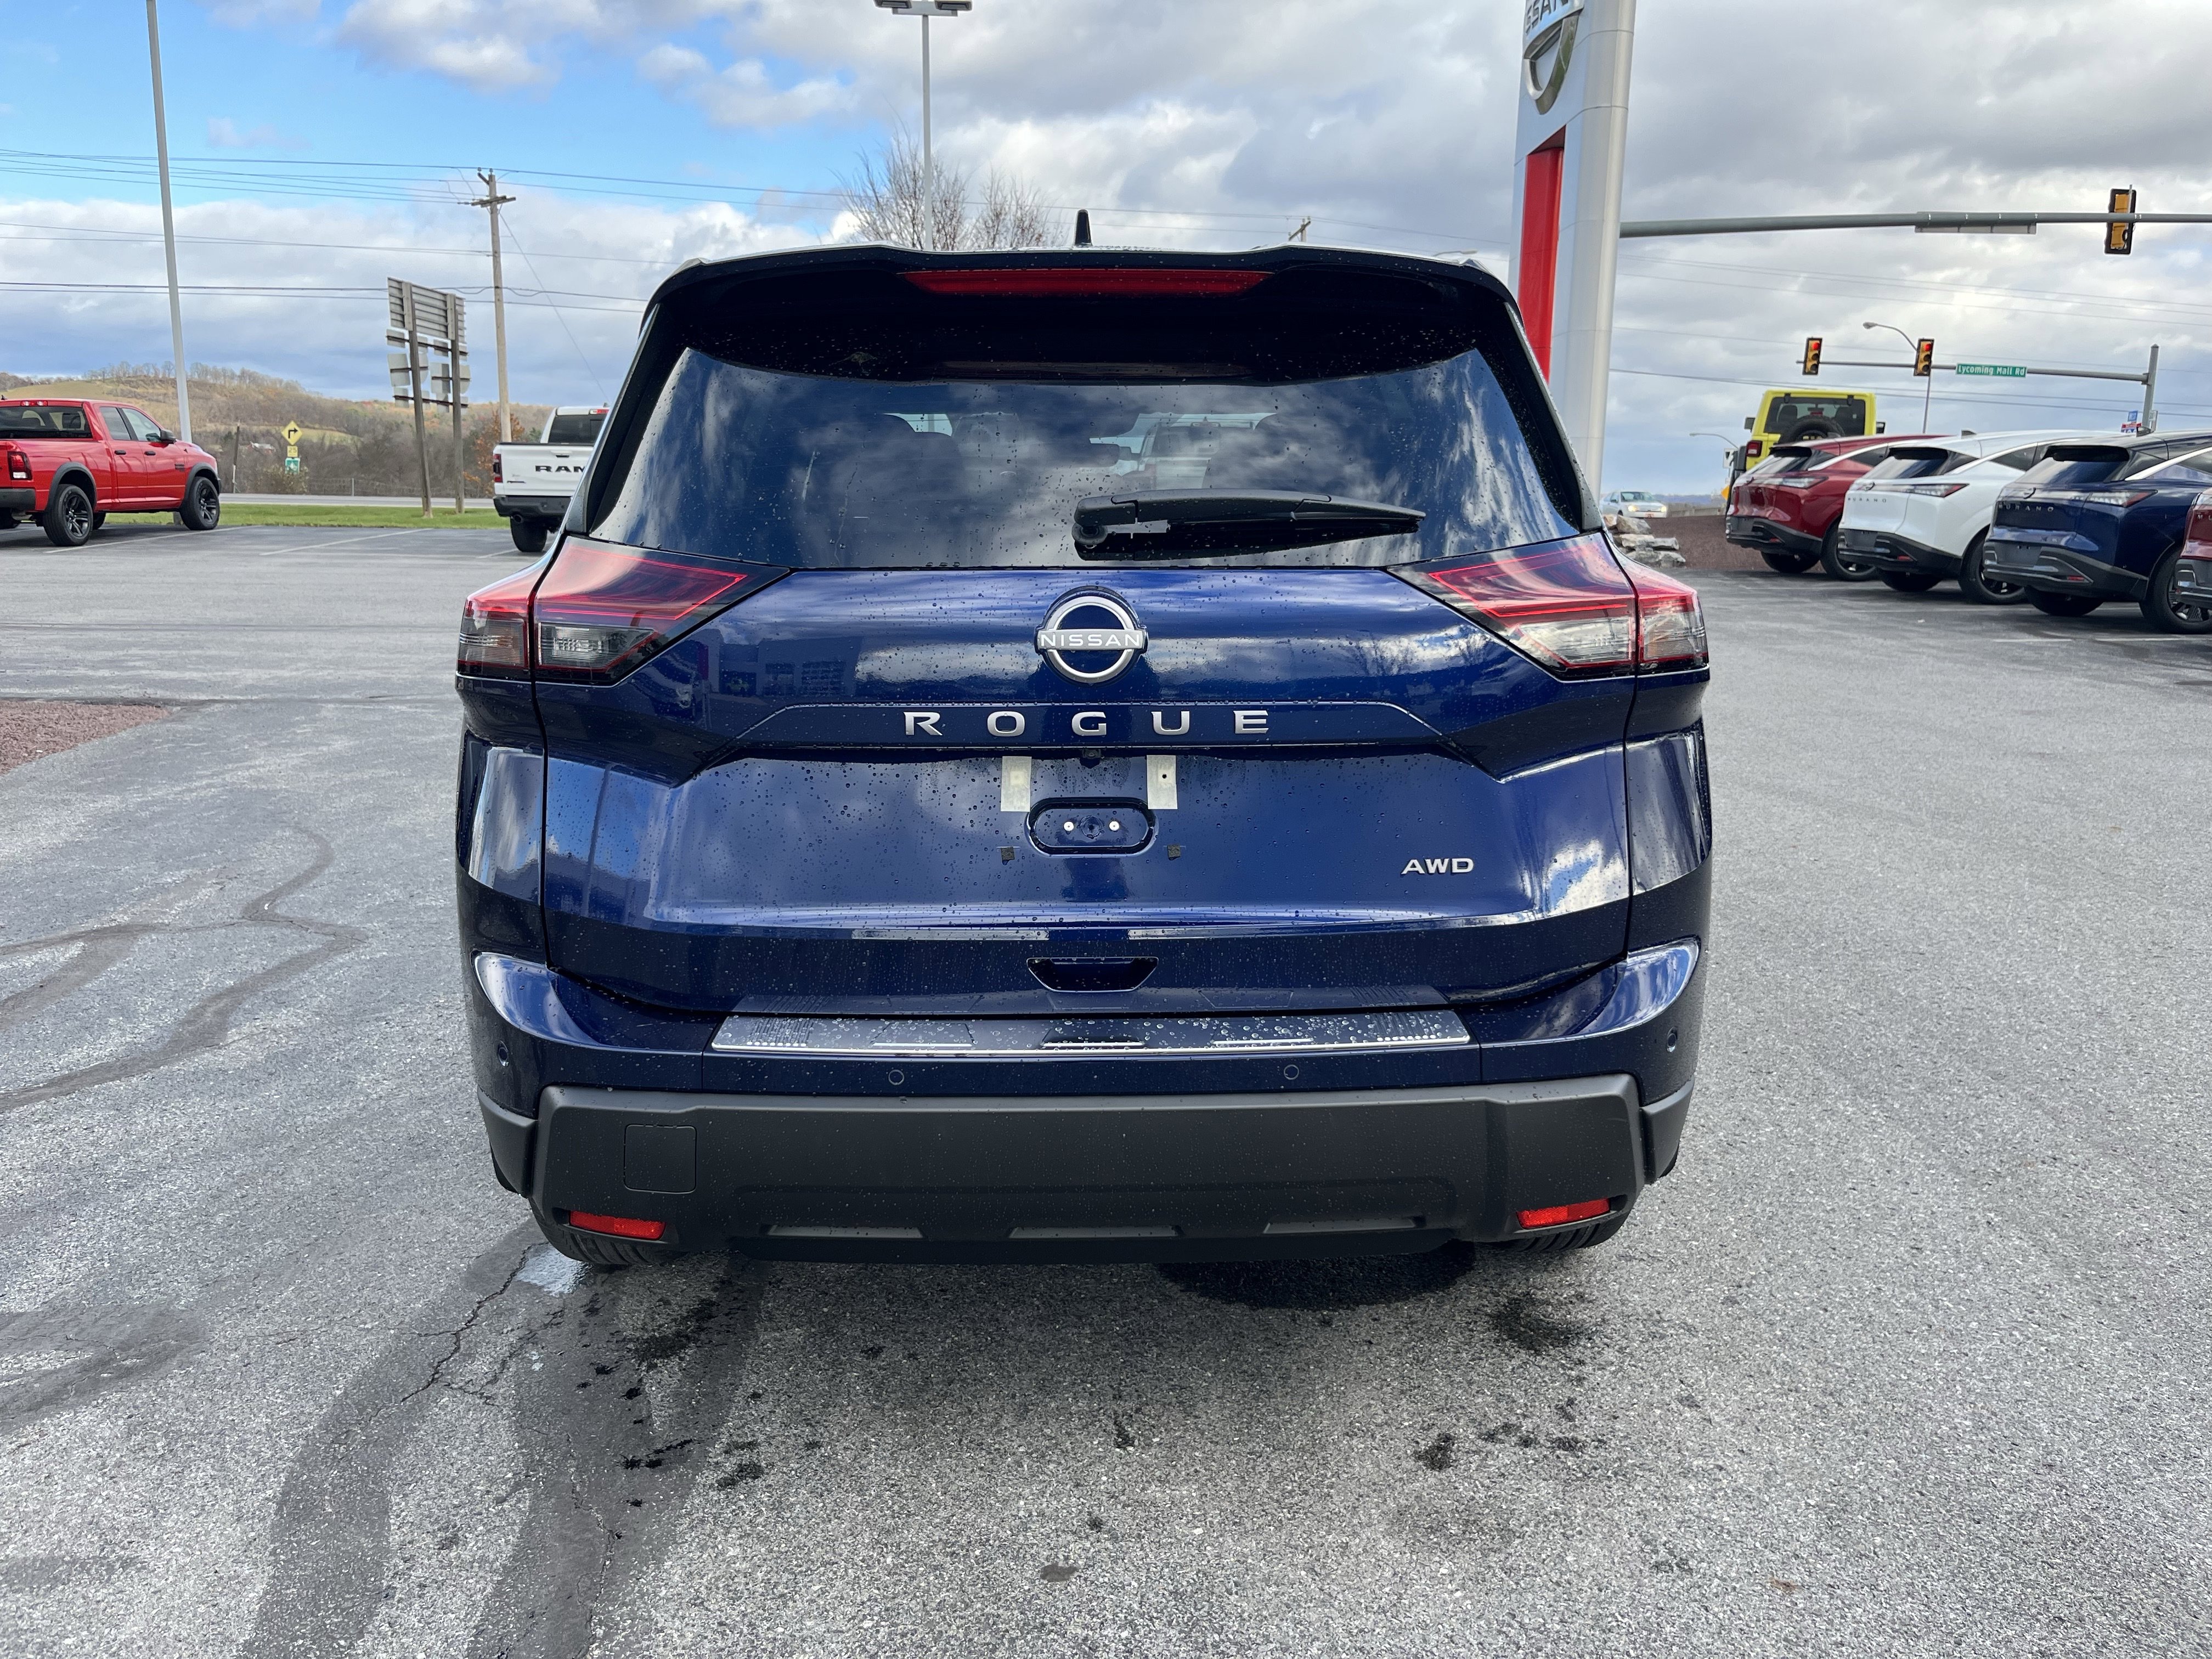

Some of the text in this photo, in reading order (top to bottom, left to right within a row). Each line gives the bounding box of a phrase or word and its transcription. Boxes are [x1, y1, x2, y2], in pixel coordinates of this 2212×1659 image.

[1958, 364, 2025, 376] Lycoming Mall Rd
[1041, 634, 1140, 647] NISSAN
[904, 710, 1269, 737] ROGUE
[1401, 857, 1474, 875] AWD
